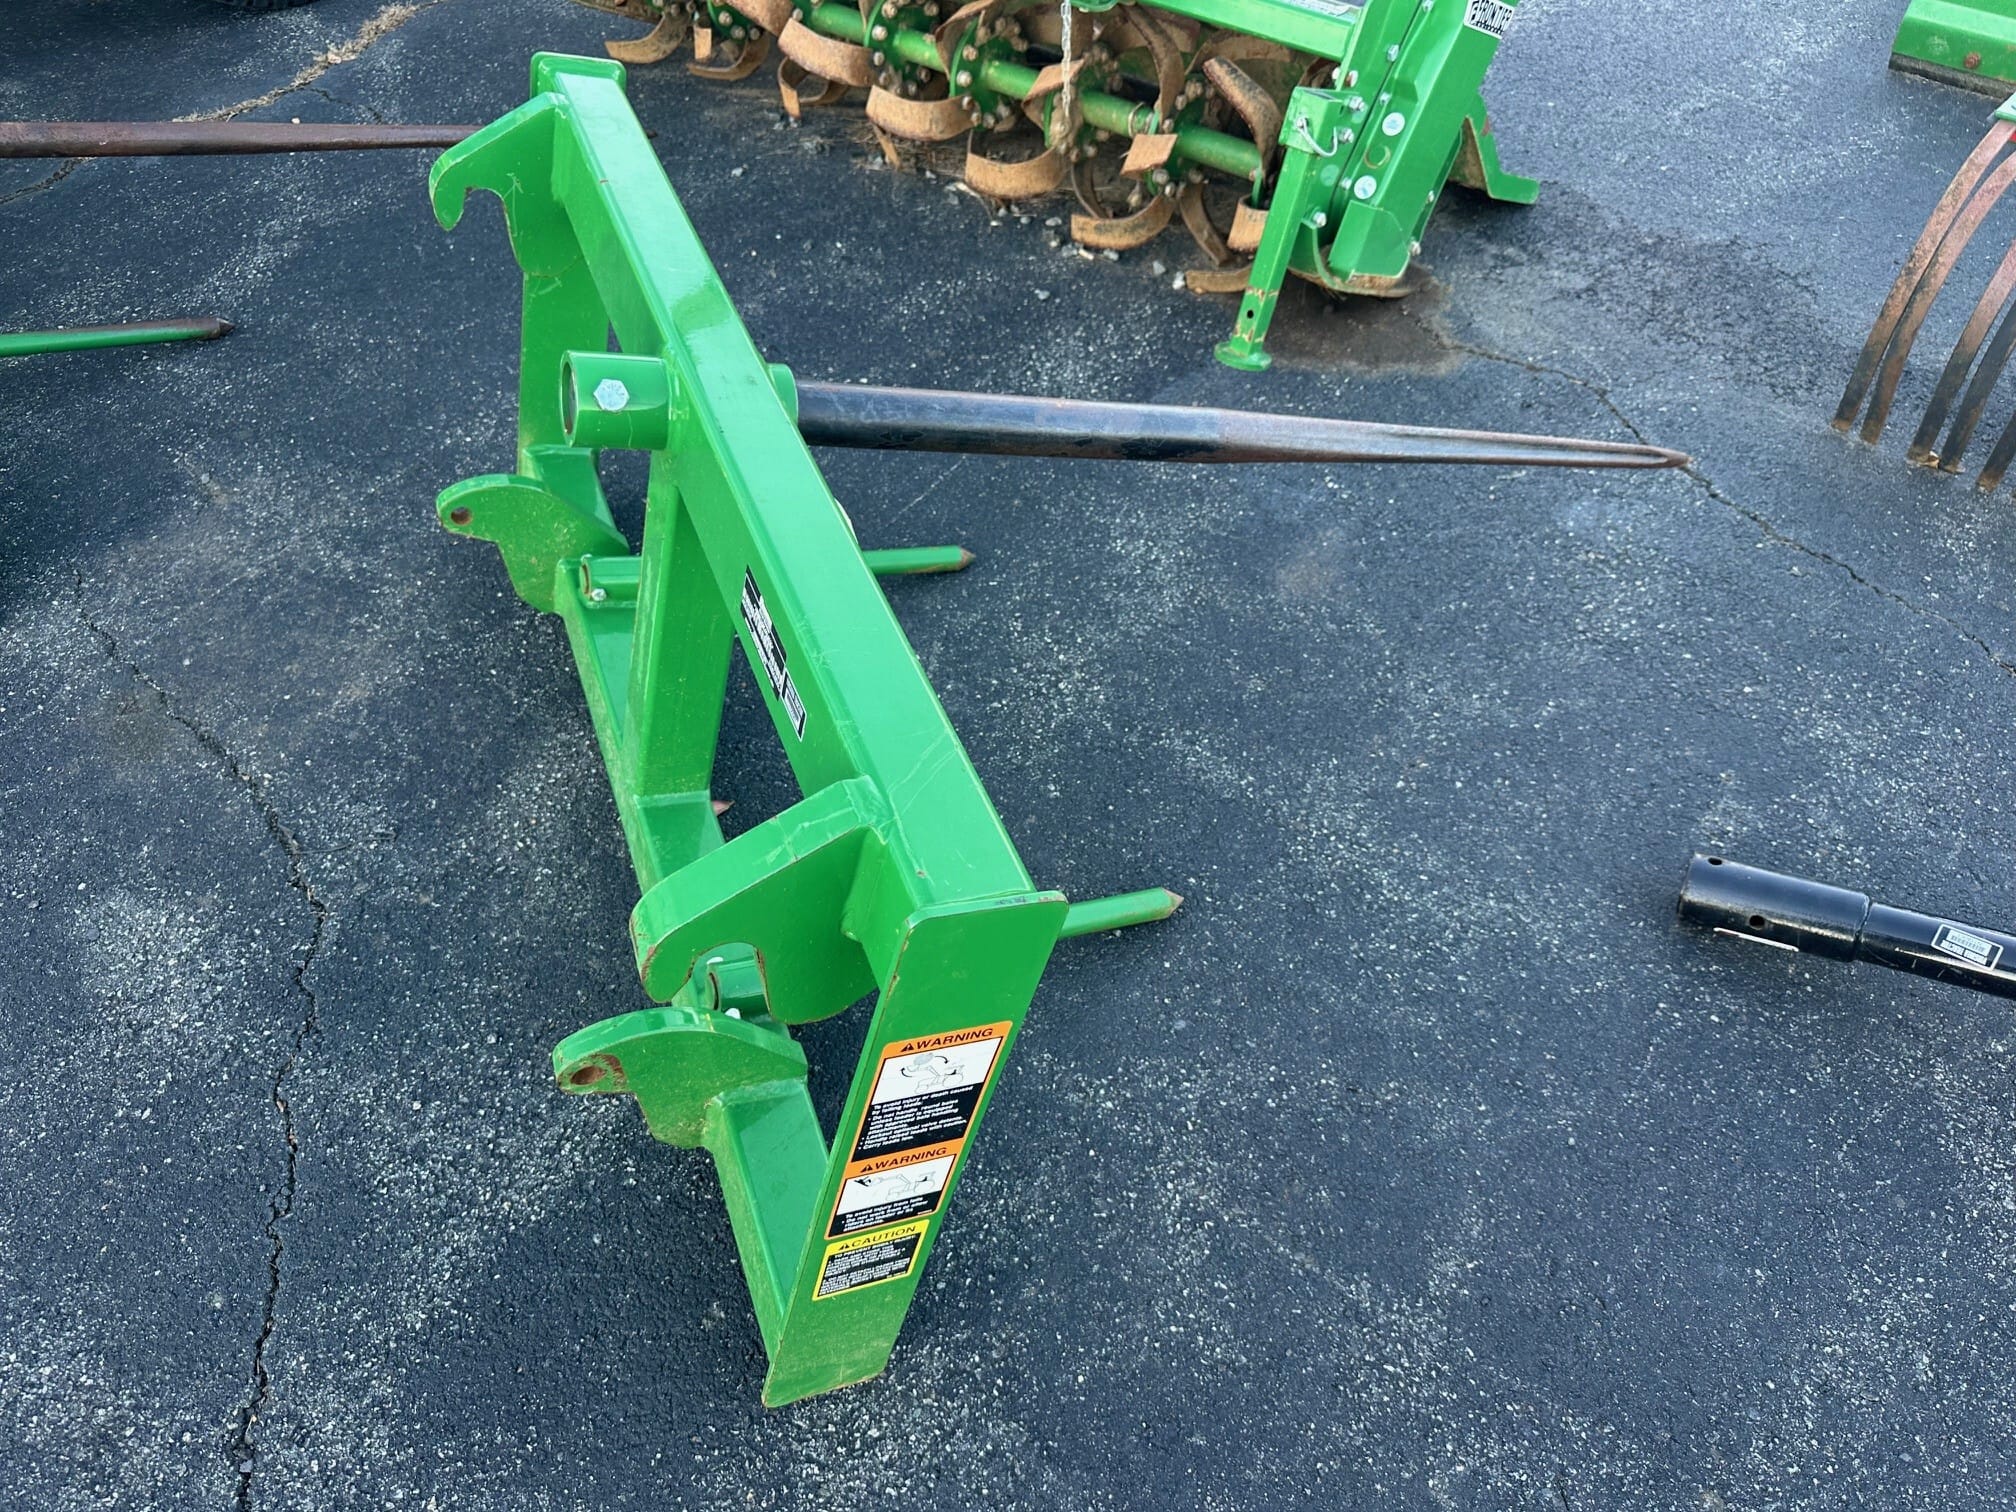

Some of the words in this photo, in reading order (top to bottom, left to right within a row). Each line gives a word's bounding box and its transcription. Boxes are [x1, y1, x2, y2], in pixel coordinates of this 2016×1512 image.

[916, 1028, 993, 1050] WARNING
[875, 1147, 947, 1170] WARNING
[852, 1225, 916, 1248] CAUTION
